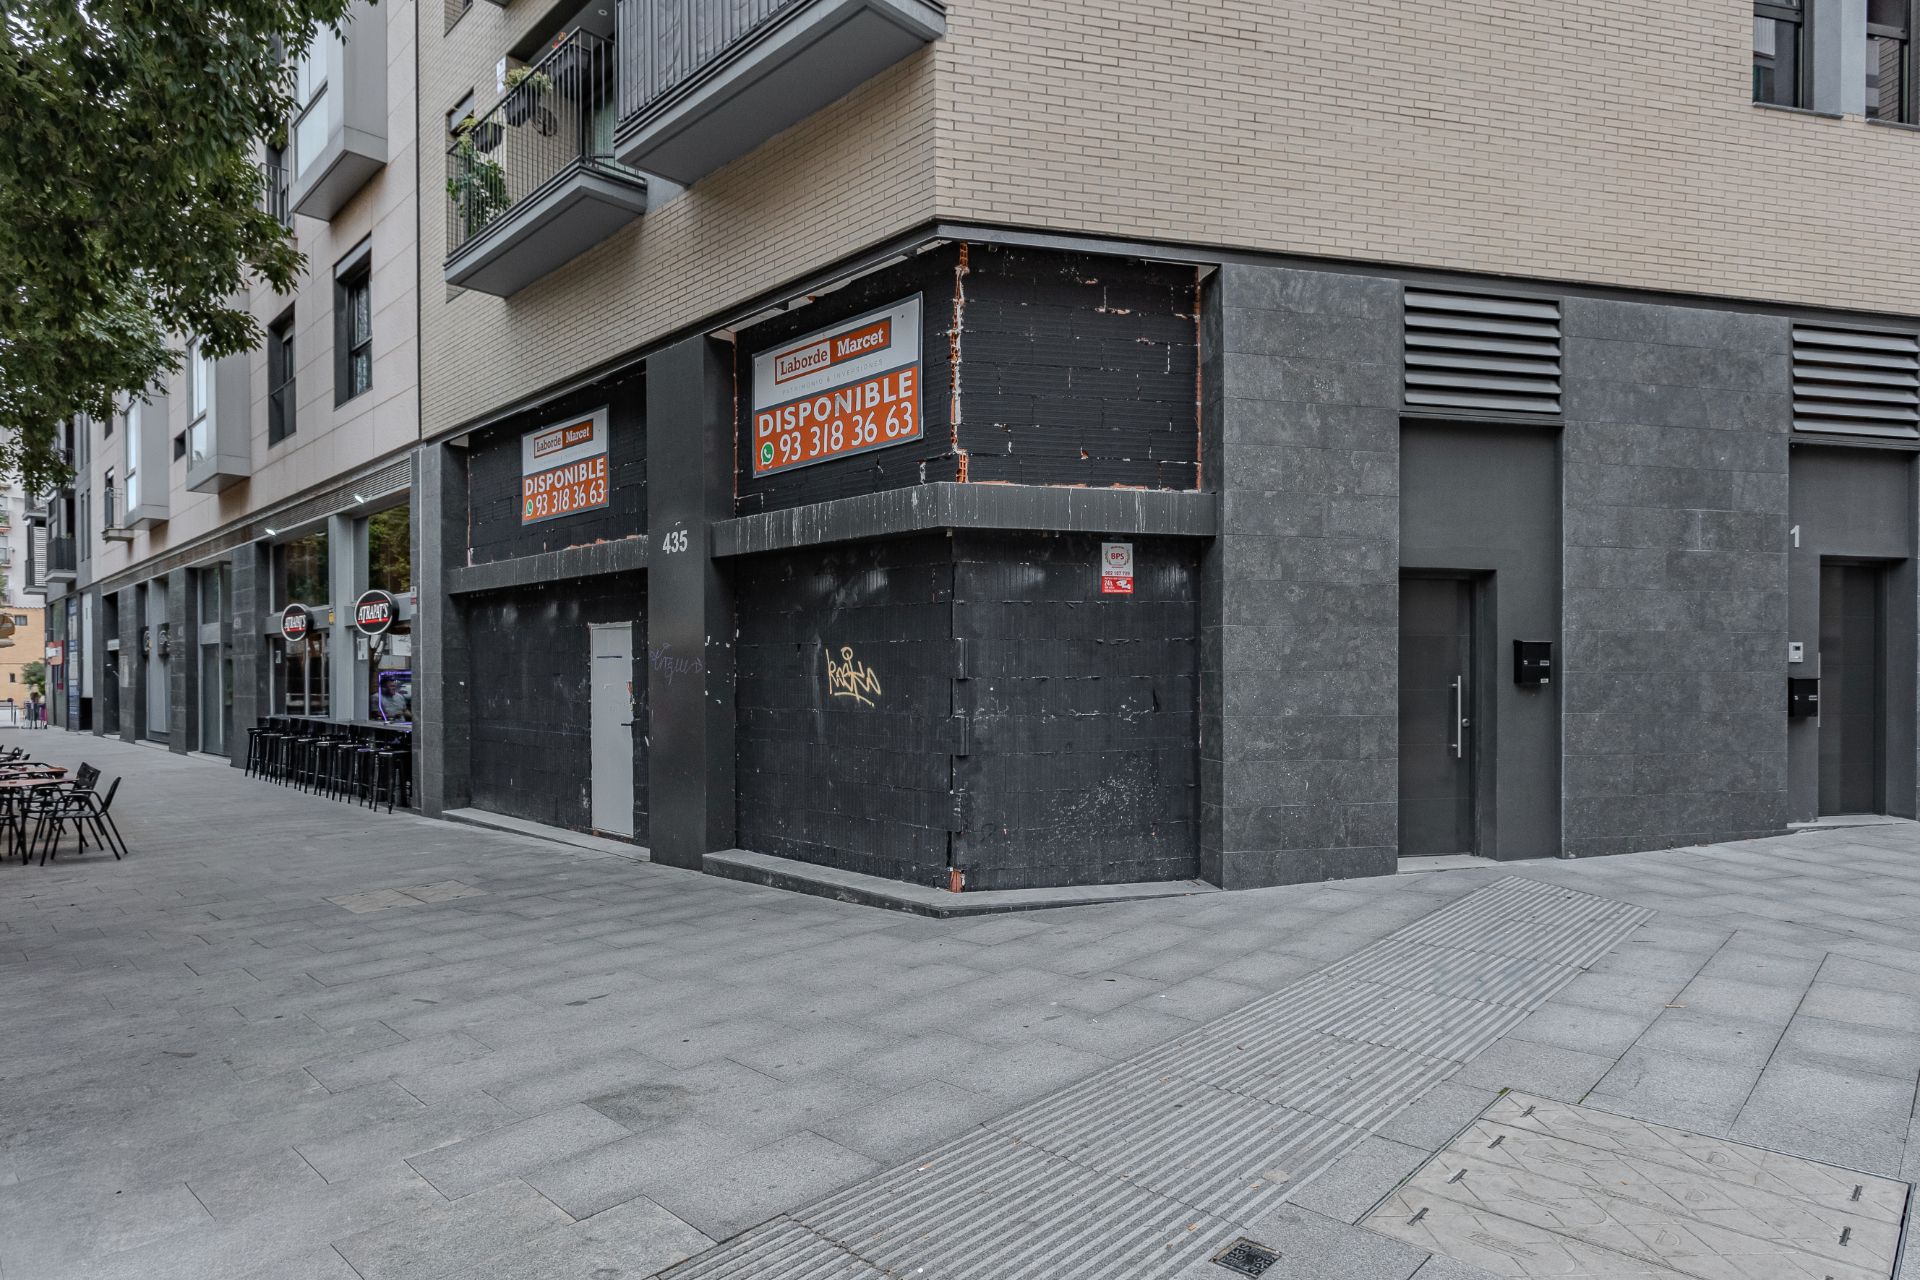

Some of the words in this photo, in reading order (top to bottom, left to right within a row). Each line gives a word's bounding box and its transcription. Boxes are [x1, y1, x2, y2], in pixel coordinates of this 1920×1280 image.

[780, 348, 828, 376] Laborde
[837, 327, 884, 357] Marcet
[759, 371, 913, 438] DISPONIBLE
[536, 435, 562, 452] Laborde
[565, 426, 590, 444] Marcet
[780, 431, 801, 463] 93
[809, 420, 844, 456] 318
[851, 410, 878, 446] 36
[886, 401, 913, 438] 63
[525, 458, 605, 496] DISPONIBLE
[535, 493, 548, 516] 93
[551, 488, 570, 513] 318
[573, 484, 586, 508] 36
[589, 479, 605, 504] 63
[662, 530, 688, 554] 435
[1790, 525, 1800, 548] 1
[358, 602, 389, 624] ATRAPAT'S
